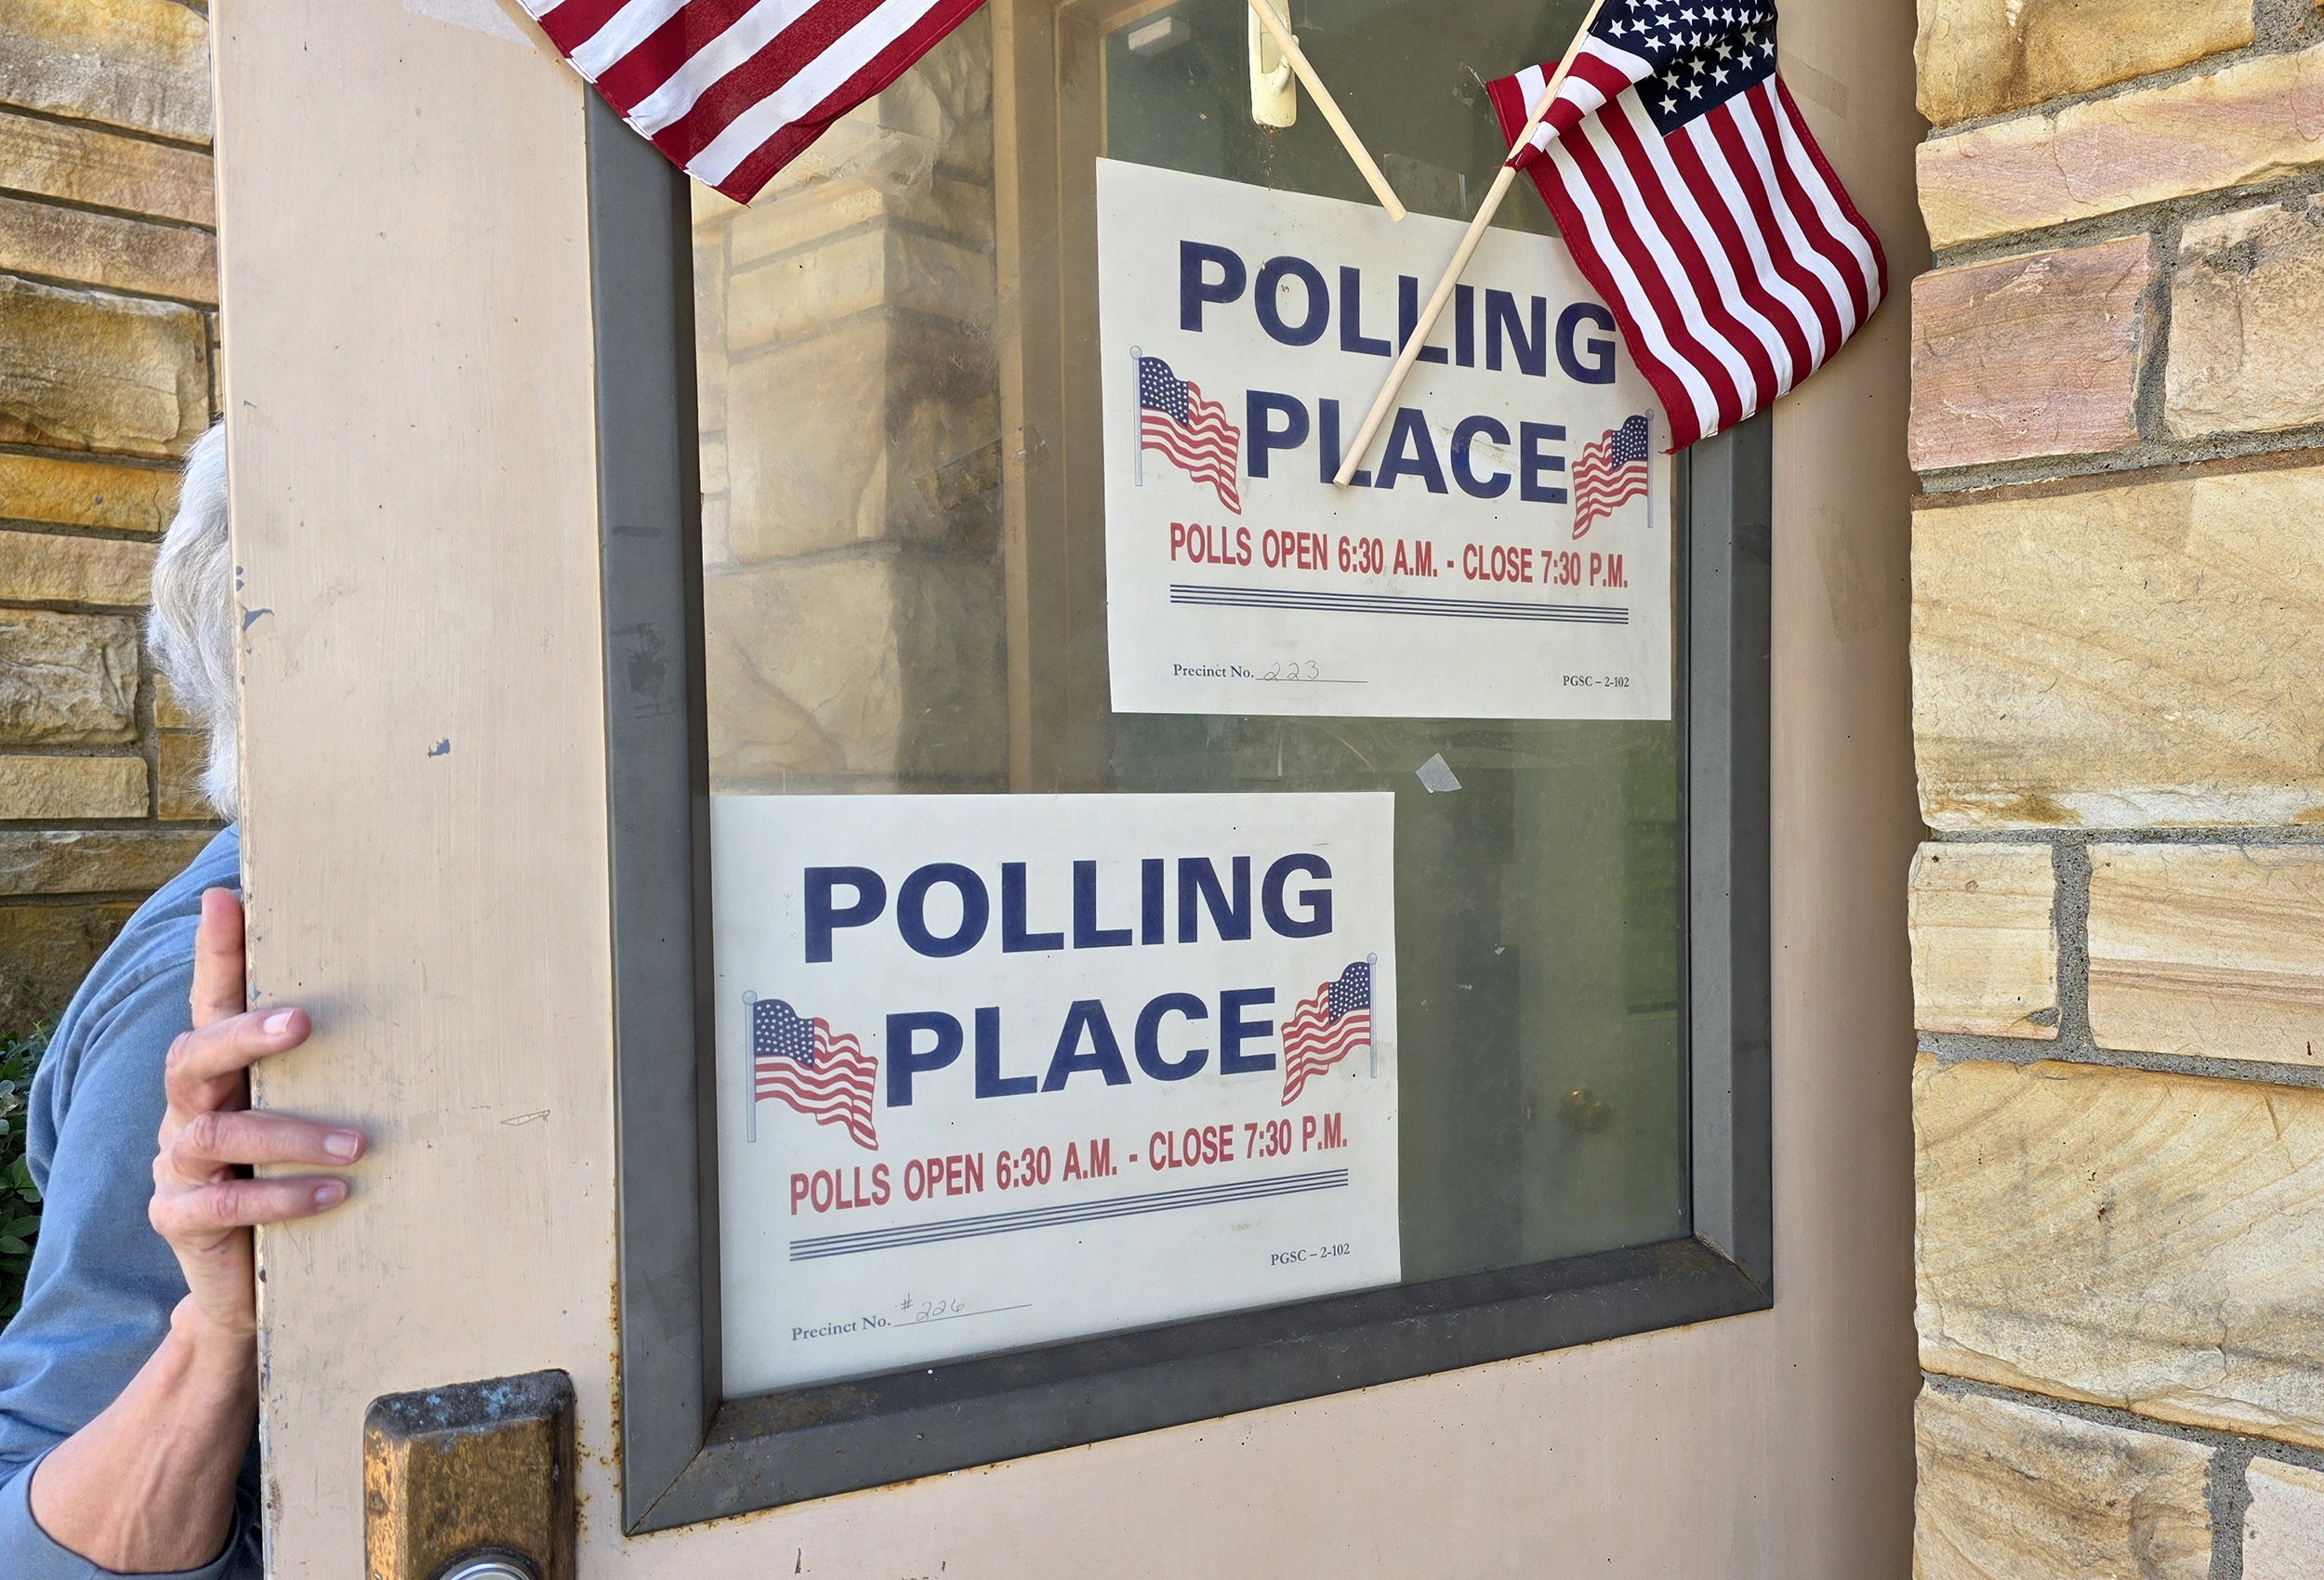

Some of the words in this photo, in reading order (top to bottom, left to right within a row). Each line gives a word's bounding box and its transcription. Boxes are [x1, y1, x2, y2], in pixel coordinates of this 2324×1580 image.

[1180, 240, 1616, 384] POLLING
[1247, 389, 1567, 505] PLACE
[1170, 522, 1252, 566] POLLS
[1262, 529, 1327, 571] OPEN
[1338, 536, 1383, 574] 6:30
[1393, 539, 1438, 577] A.M.
[1463, 543, 1533, 583] CLOSE
[1541, 550, 1580, 586] 7:30
[1590, 552, 1628, 588] P.M.
[1173, 664, 1226, 678] Precinct
[1230, 665, 1254, 678] No.
[1263, 660, 1319, 681] 223
[1563, 676, 1593, 687] PGSC
[1604, 676, 1630, 687] 2-102
[804, 853, 1333, 963] POLLING
[886, 987, 1277, 1107] PLACE
[790, 1163, 891, 1215] POLLS
[904, 1152, 984, 1201] OPEN
[997, 1146, 1051, 1190] 6:30
[1063, 1138, 1117, 1181] A.M.
[1129, 1153, 1138, 1162] -
[1149, 1125, 1235, 1171] CLOSE
[1244, 1118, 1291, 1159] 7:30
[1302, 1113, 1348, 1152] P.M.
[1271, 1249, 1306, 1266] PGSC
[1320, 1243, 1350, 1258] 2-102
[791, 1323, 856, 1340] Precinct
[862, 1315, 891, 1330] No.
